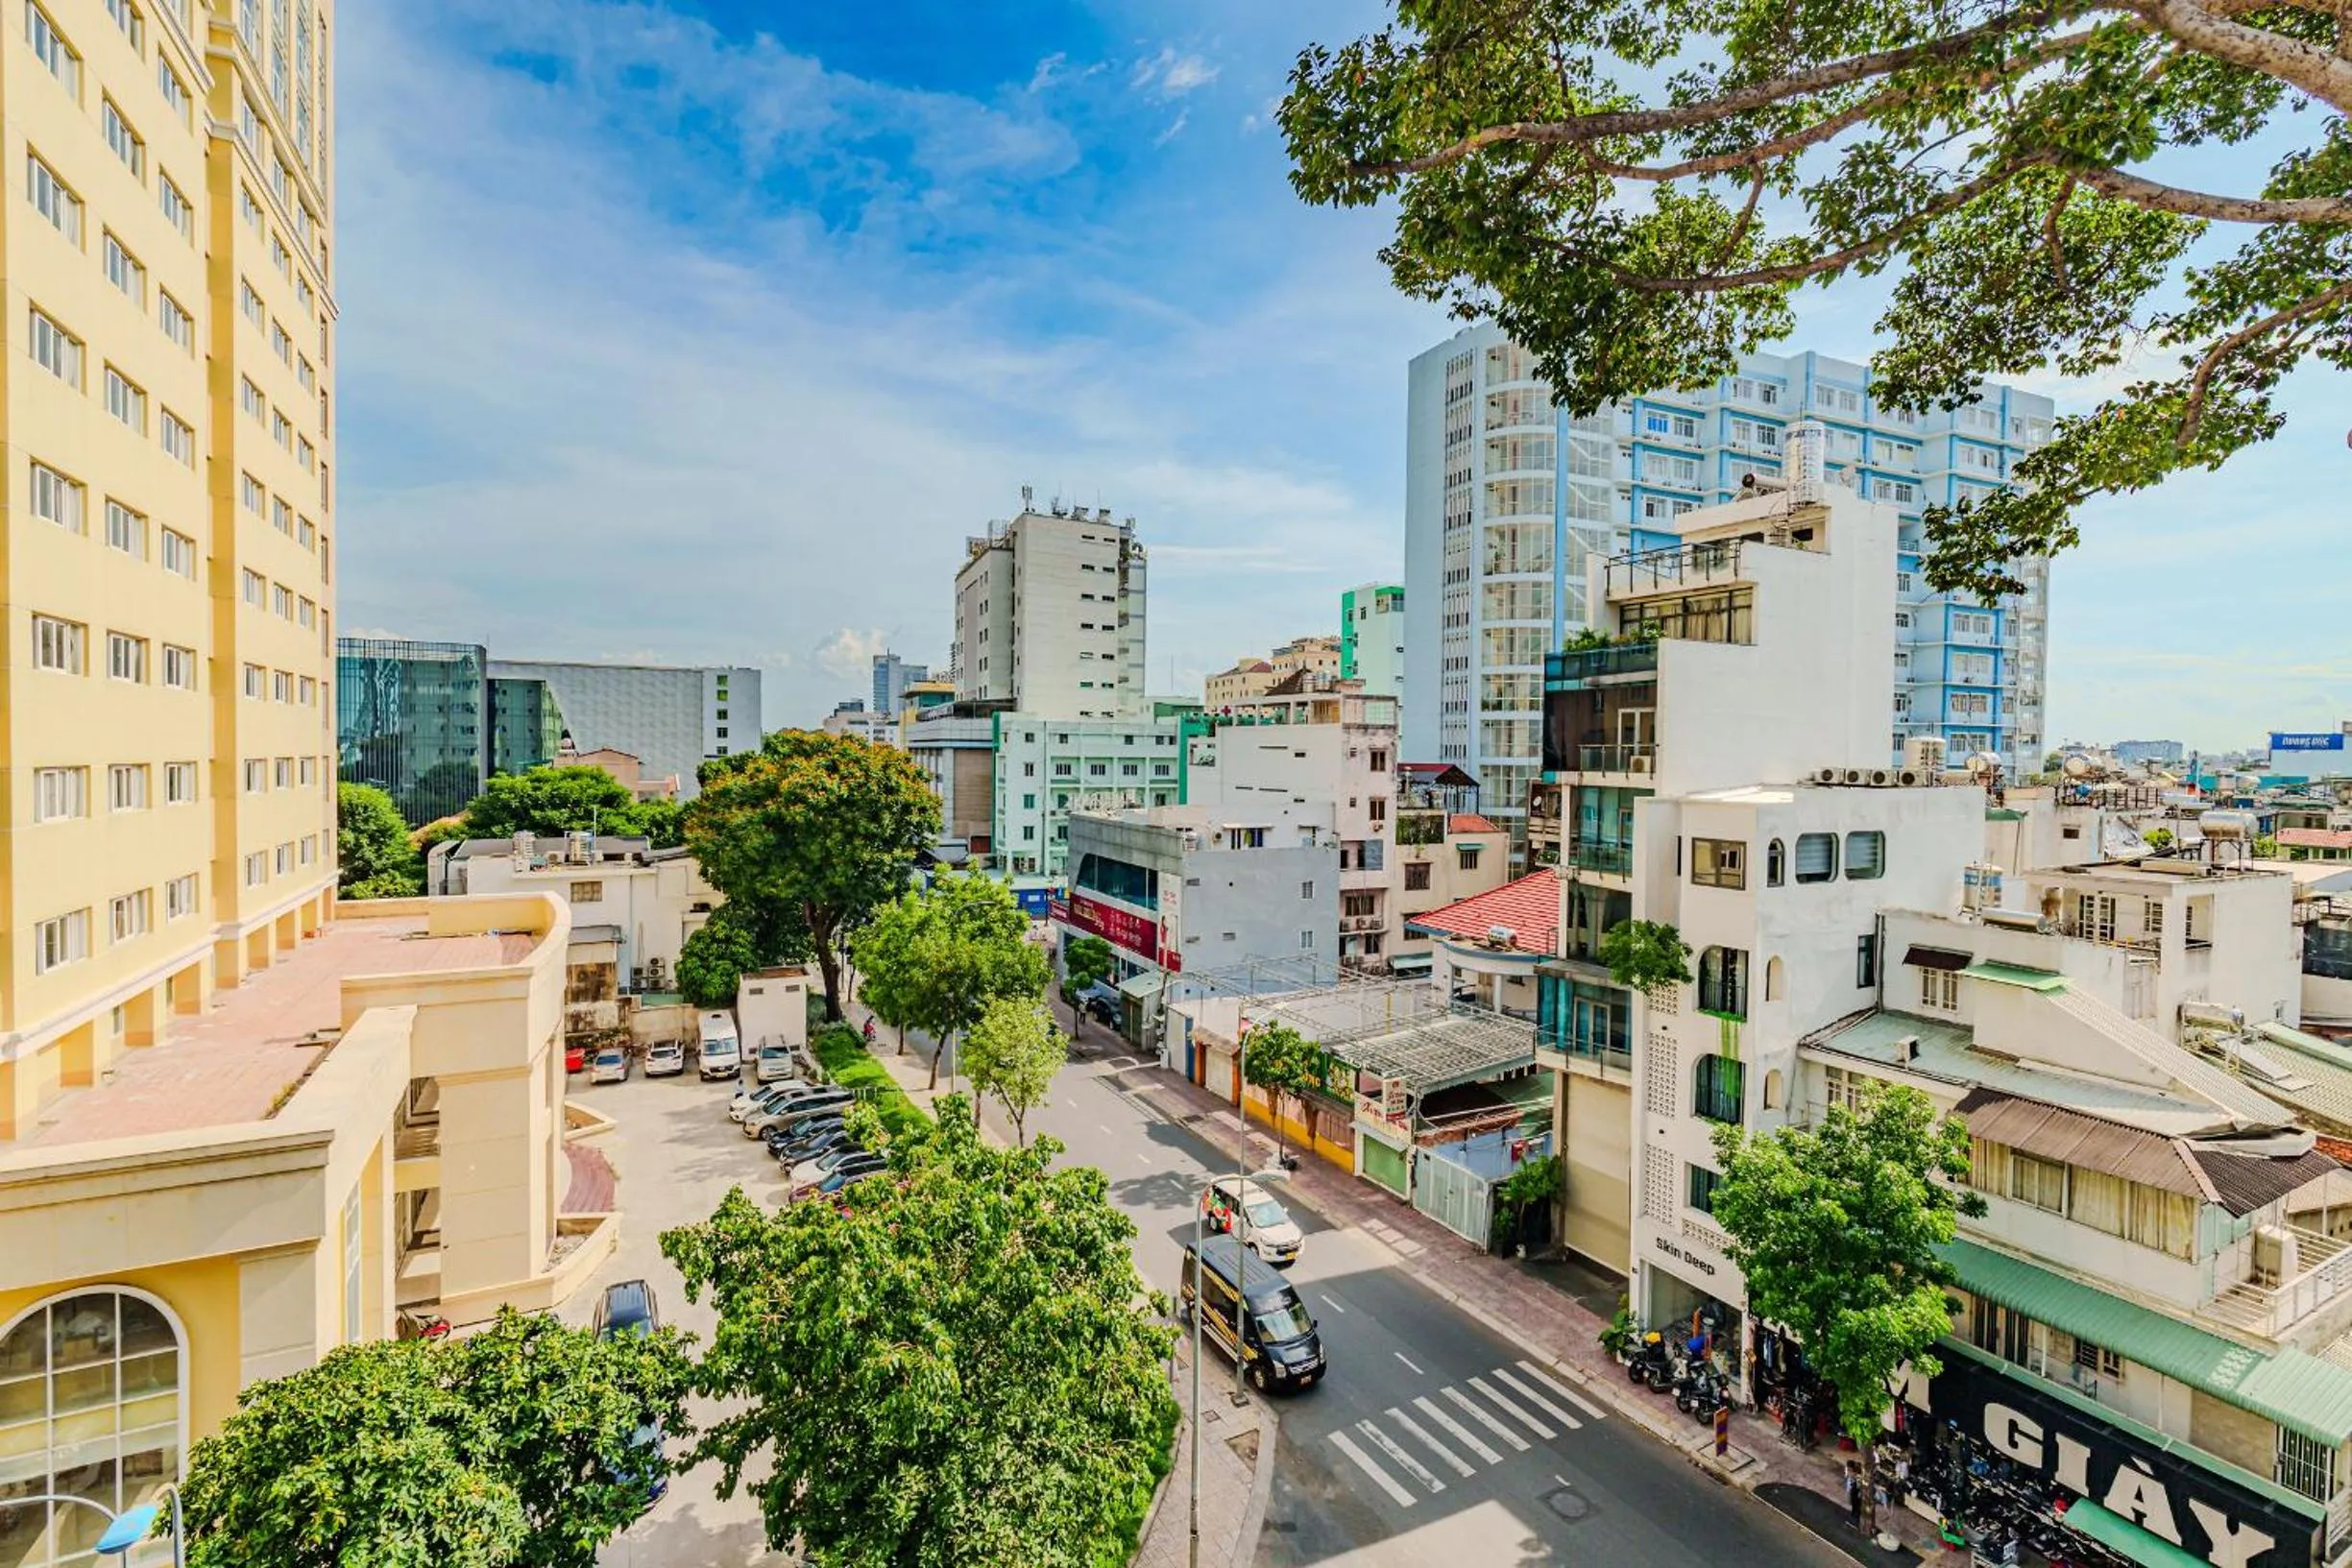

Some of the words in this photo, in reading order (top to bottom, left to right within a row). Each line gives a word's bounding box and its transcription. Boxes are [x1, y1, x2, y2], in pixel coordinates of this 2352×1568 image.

[1656, 1237, 1682, 1259] Skin
[1685, 1250, 1716, 1275] Deep
[1984, 1402, 2275, 1568] GIÀY
